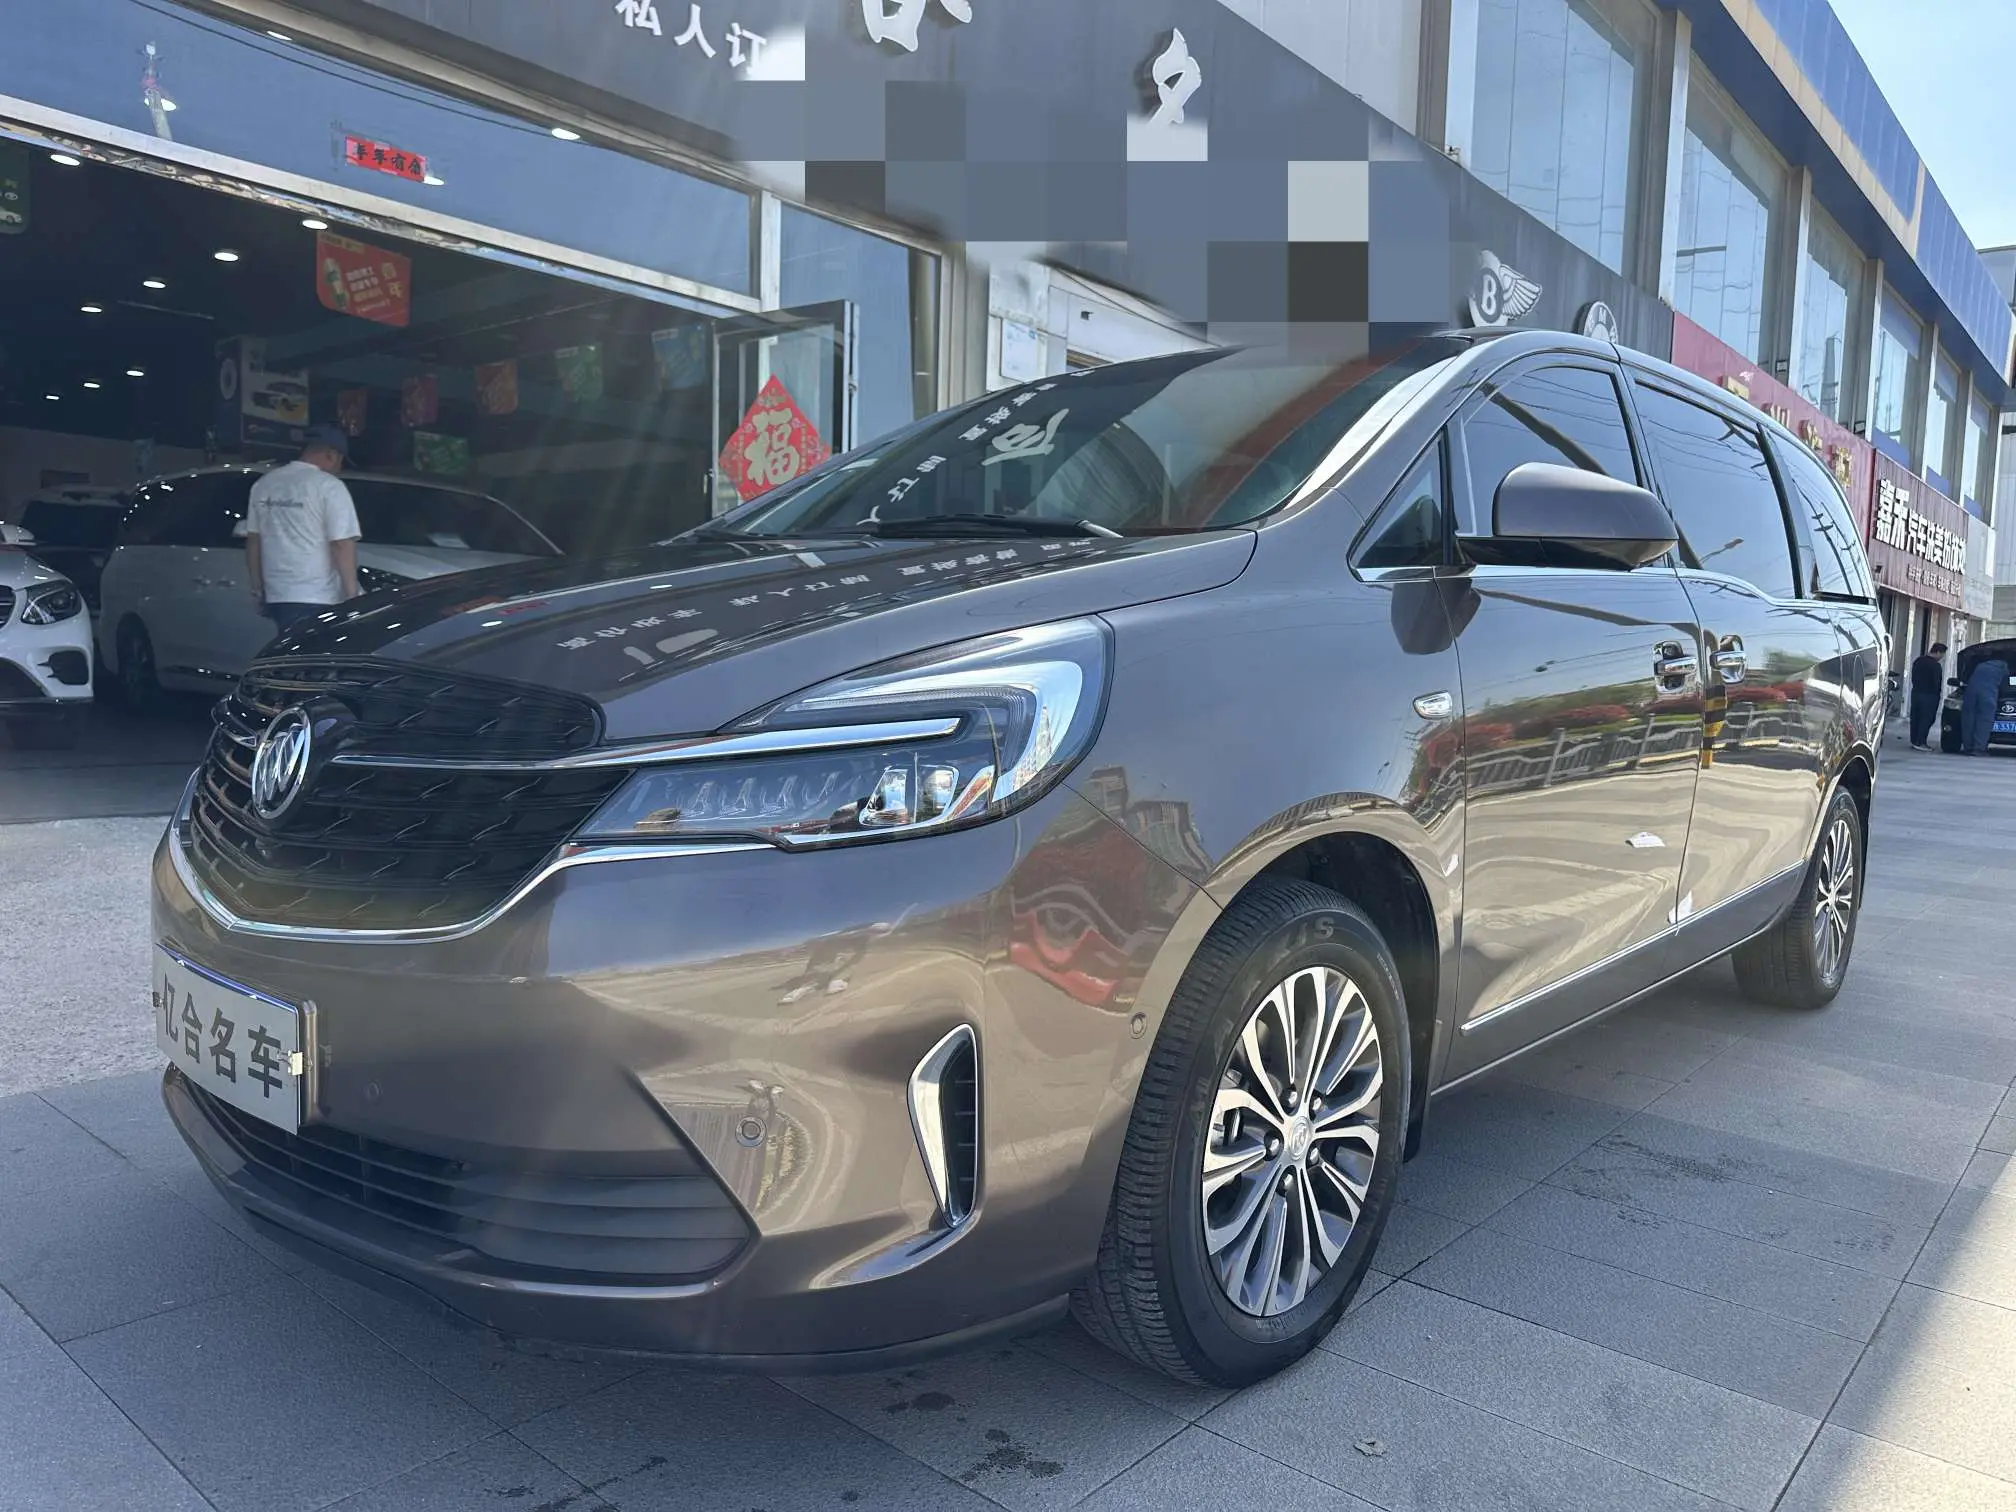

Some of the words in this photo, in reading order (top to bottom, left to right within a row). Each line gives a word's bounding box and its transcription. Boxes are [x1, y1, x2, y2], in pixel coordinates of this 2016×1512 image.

[744, 407, 801, 487] 福
[163, 972, 283, 1099] 亿合名车
